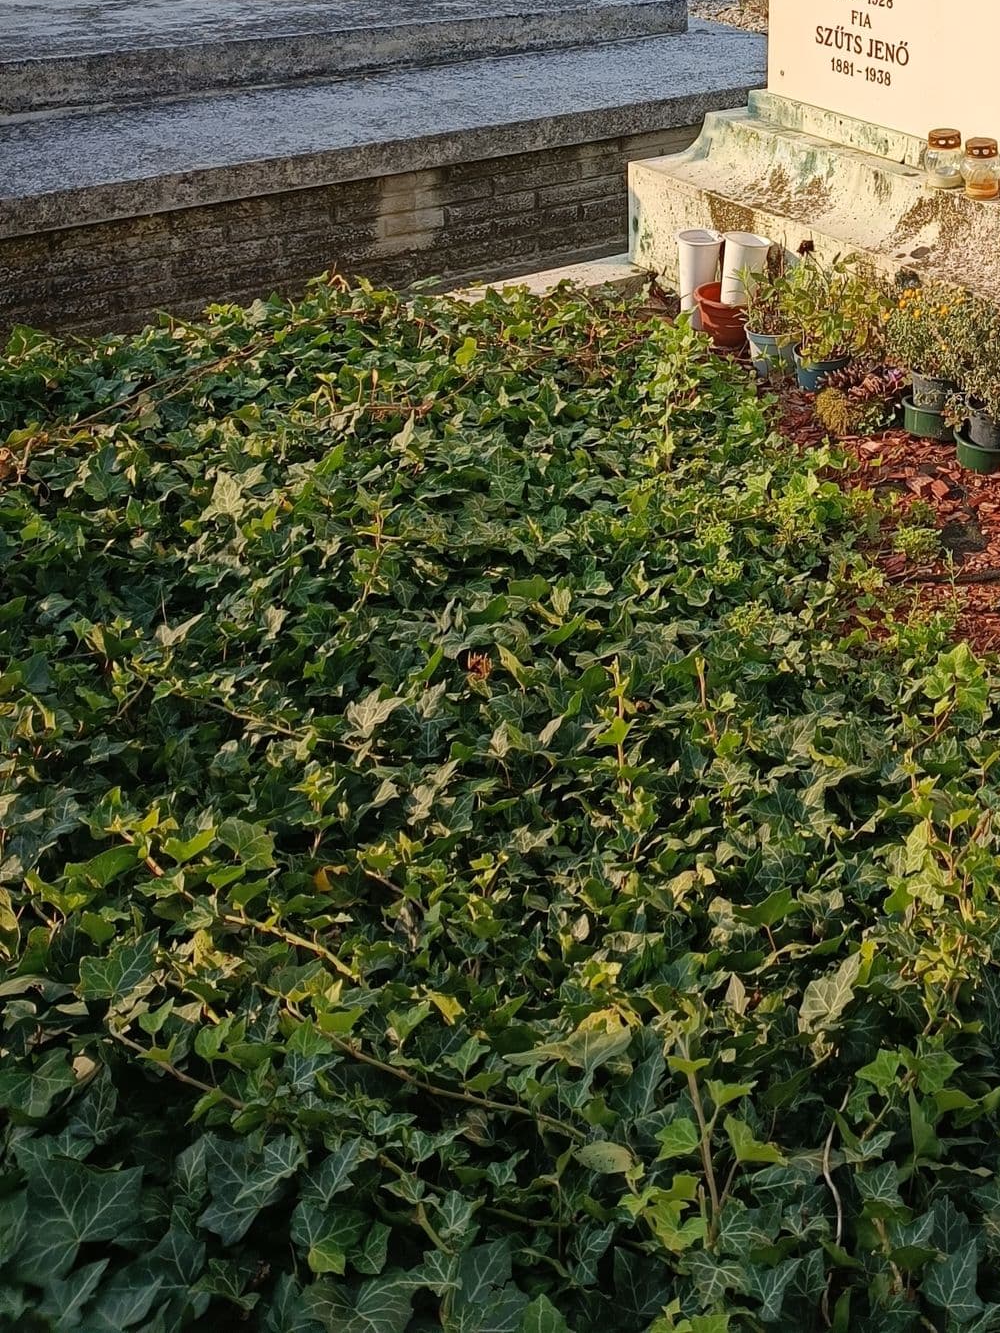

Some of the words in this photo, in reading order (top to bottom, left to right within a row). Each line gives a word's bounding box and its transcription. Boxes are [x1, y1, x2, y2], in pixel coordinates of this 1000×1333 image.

[851, 9, 873, 30] FIA
[814, 24, 863, 55] SZŰTS
[866, 38, 910, 67] JENŐ
